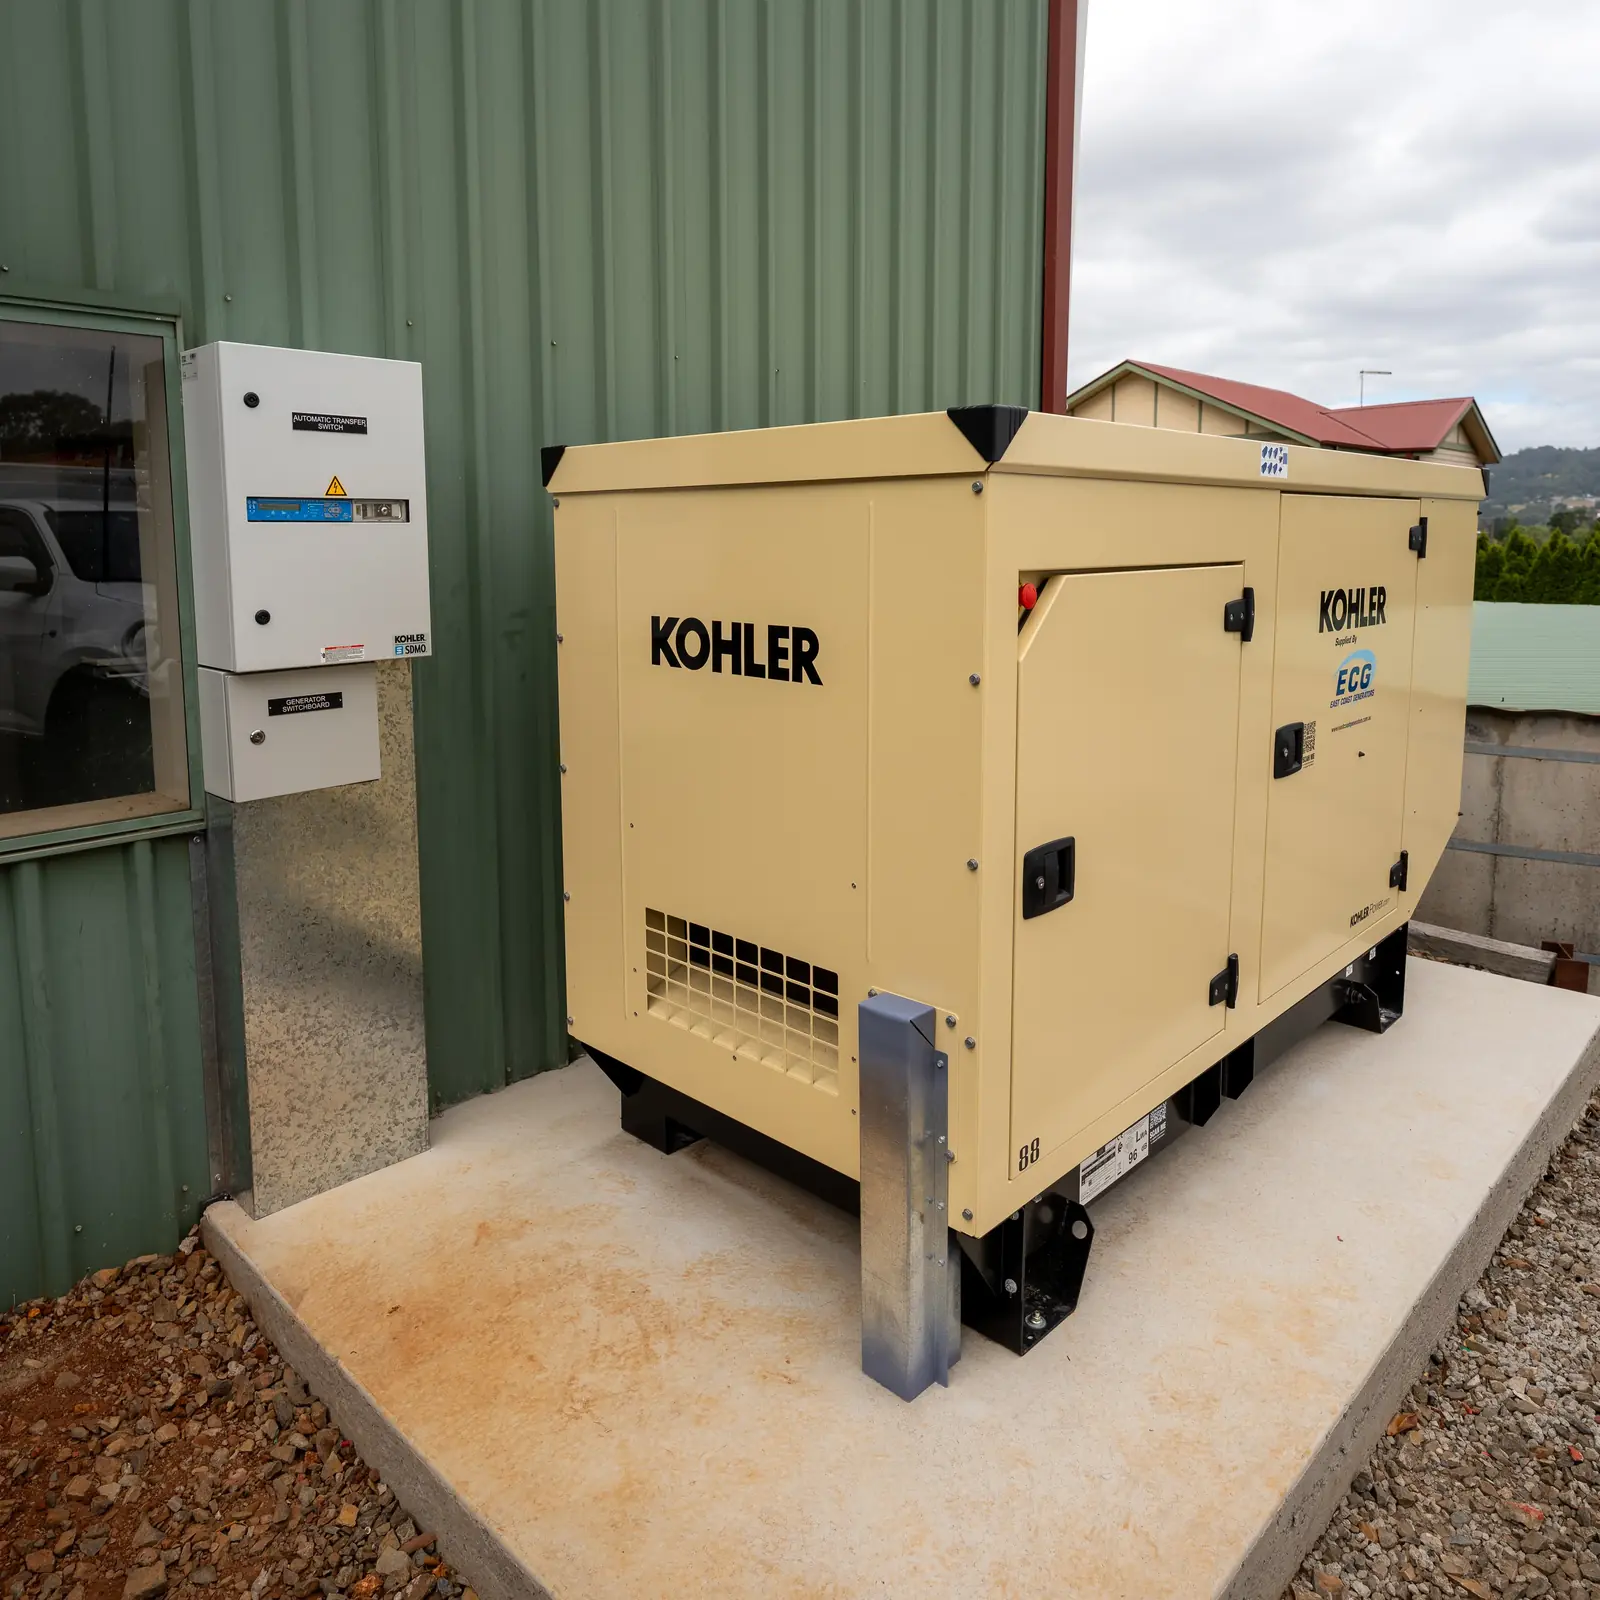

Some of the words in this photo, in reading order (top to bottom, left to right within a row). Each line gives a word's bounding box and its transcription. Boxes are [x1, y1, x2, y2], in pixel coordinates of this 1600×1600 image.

[293, 414, 332, 424] AUTOMATIC
[333, 417, 366, 426] TRANSFER
[317, 423, 344, 431] SWITCH
[1319, 586, 1387, 633] KOHLER
[394, 633, 426, 644] KOHLER
[1335, 636, 1352, 647] Supplied
[1352, 634, 1358, 645] By
[405, 644, 427, 654] SDMO
[651, 615, 824, 686] KOHLER
[1336, 663, 1372, 697] ECG
[285, 695, 326, 706] GENERATOR
[1330, 699, 1341, 708] EAST
[1340, 696, 1353, 706] COAST
[1352, 689, 1375, 702] GENERATORS
[282, 701, 331, 713] SWITCHBOARD
[1018, 1137, 1040, 1172] 88
[1128, 1148, 1138, 1165] 96
